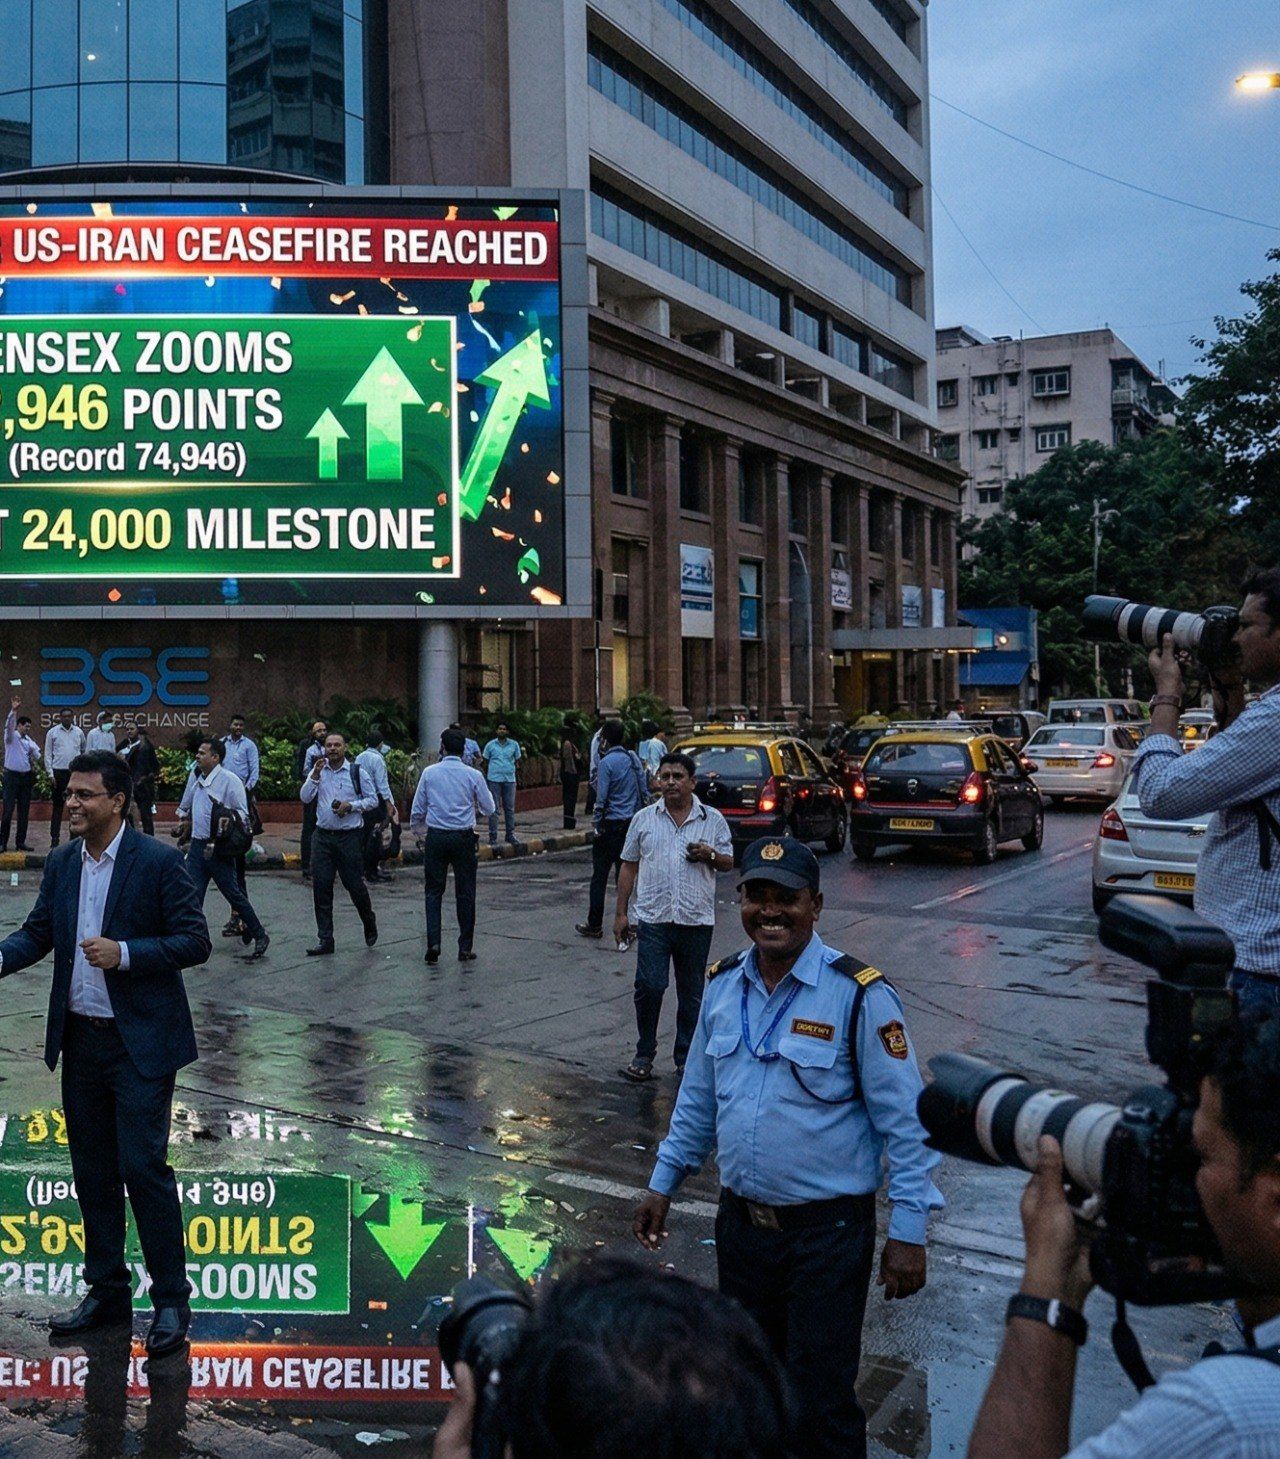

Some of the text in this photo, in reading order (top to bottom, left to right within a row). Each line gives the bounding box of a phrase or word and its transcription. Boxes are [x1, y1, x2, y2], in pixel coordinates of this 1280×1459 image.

[13, 226, 165, 264] US-IRAN
[176, 226, 372, 263] CEASEFIRE
[384, 228, 548, 266] REACHED
[135, 330, 293, 374] ZOOMS
[123, 387, 283, 431] POINTS
[9, 441, 247, 478] (Record 74,946)
[22, 507, 171, 559] 24,000
[187, 507, 436, 550] MILESTONE
[40, 647, 211, 707] BSE
